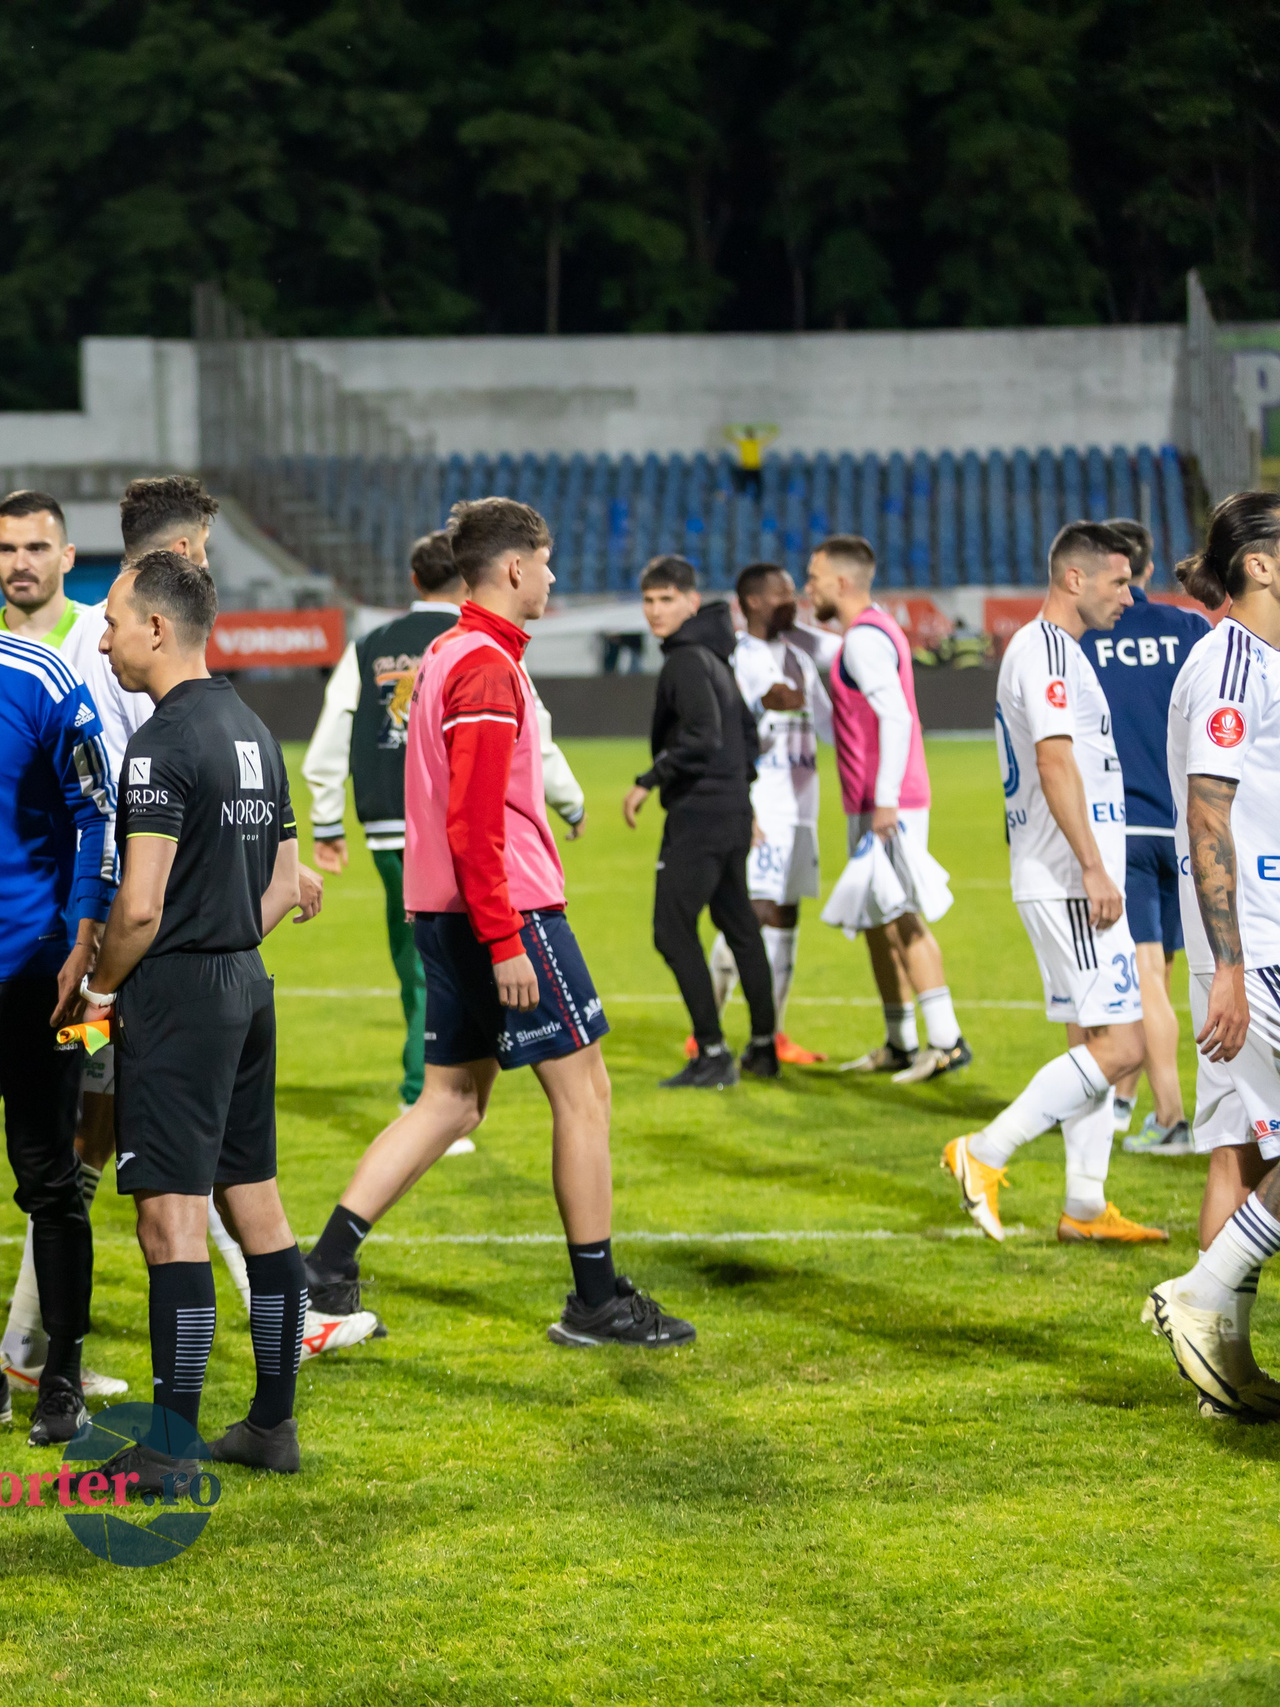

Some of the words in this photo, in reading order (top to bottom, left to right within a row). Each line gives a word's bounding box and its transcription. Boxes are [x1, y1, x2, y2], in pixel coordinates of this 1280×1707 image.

[1095, 636, 1180, 668] FCBT
[125, 789, 169, 805] ORDIS
[516, 1020, 562, 1044] Simetrix
